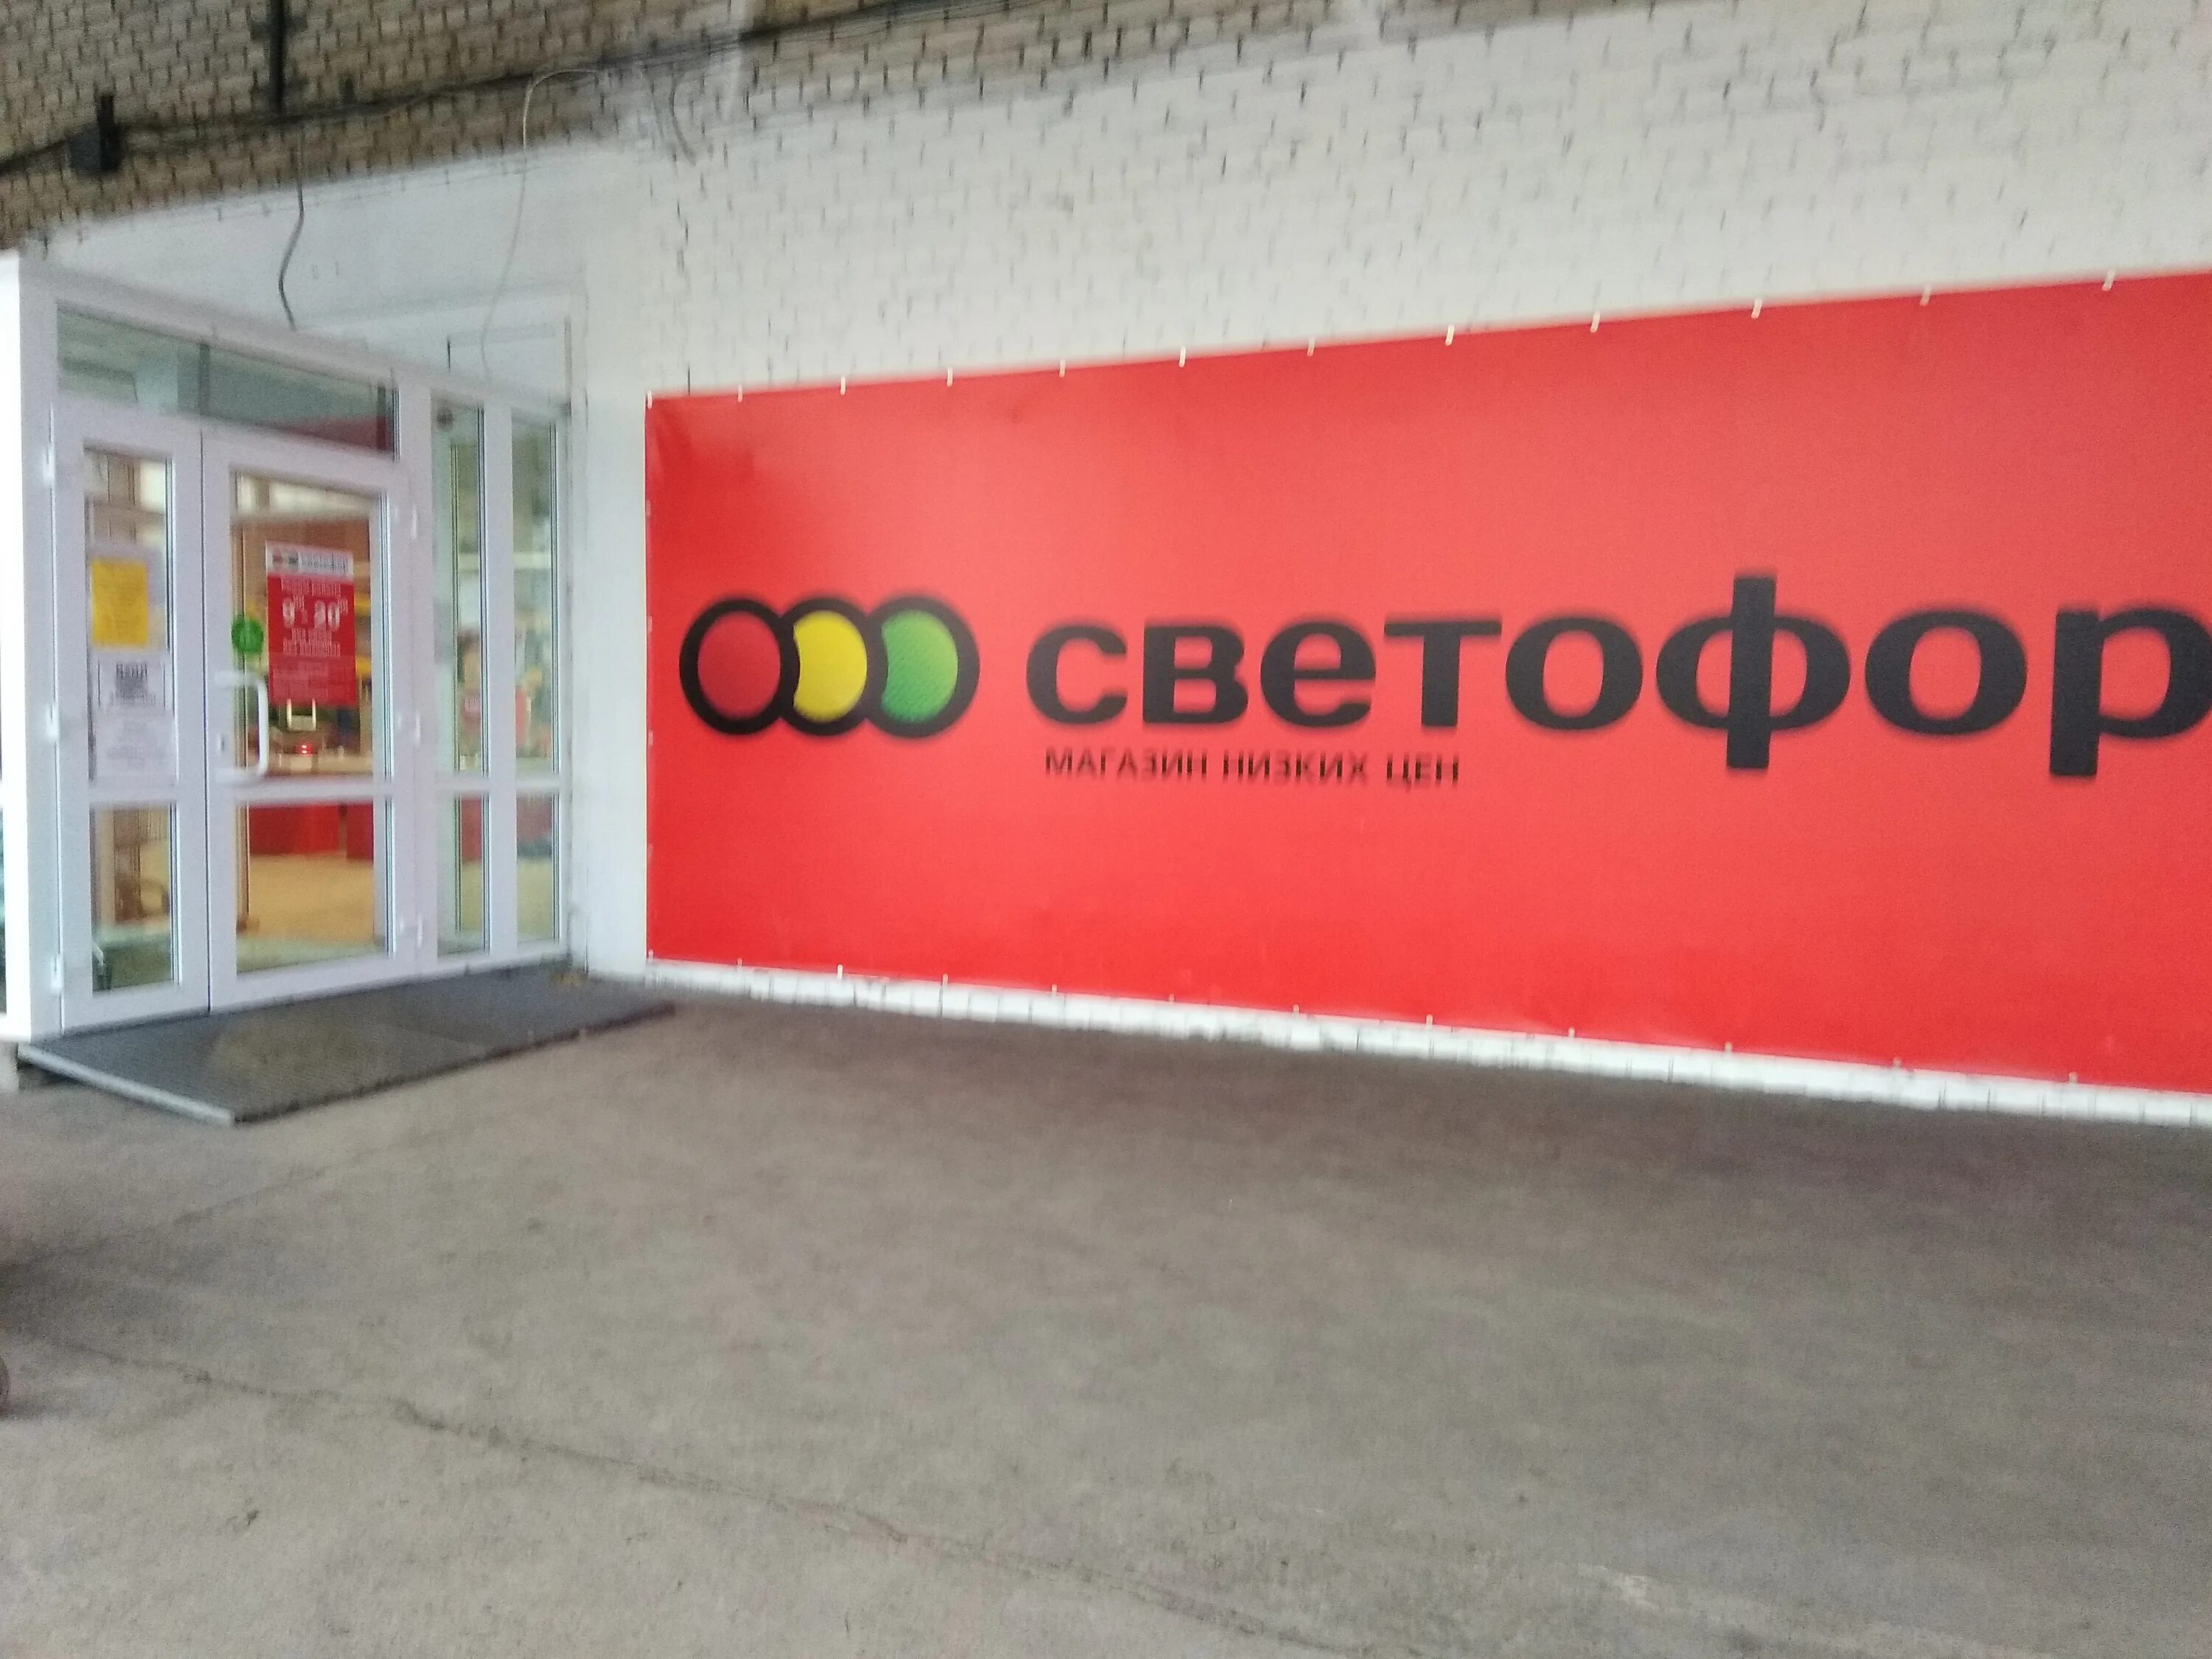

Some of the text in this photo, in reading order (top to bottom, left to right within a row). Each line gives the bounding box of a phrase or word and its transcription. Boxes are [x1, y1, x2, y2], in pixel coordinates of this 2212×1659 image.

[1025, 570, 2212, 779] светофор
[1044, 747, 1461, 791] МАГАЗИН НИЗКИХ ЦЕН
